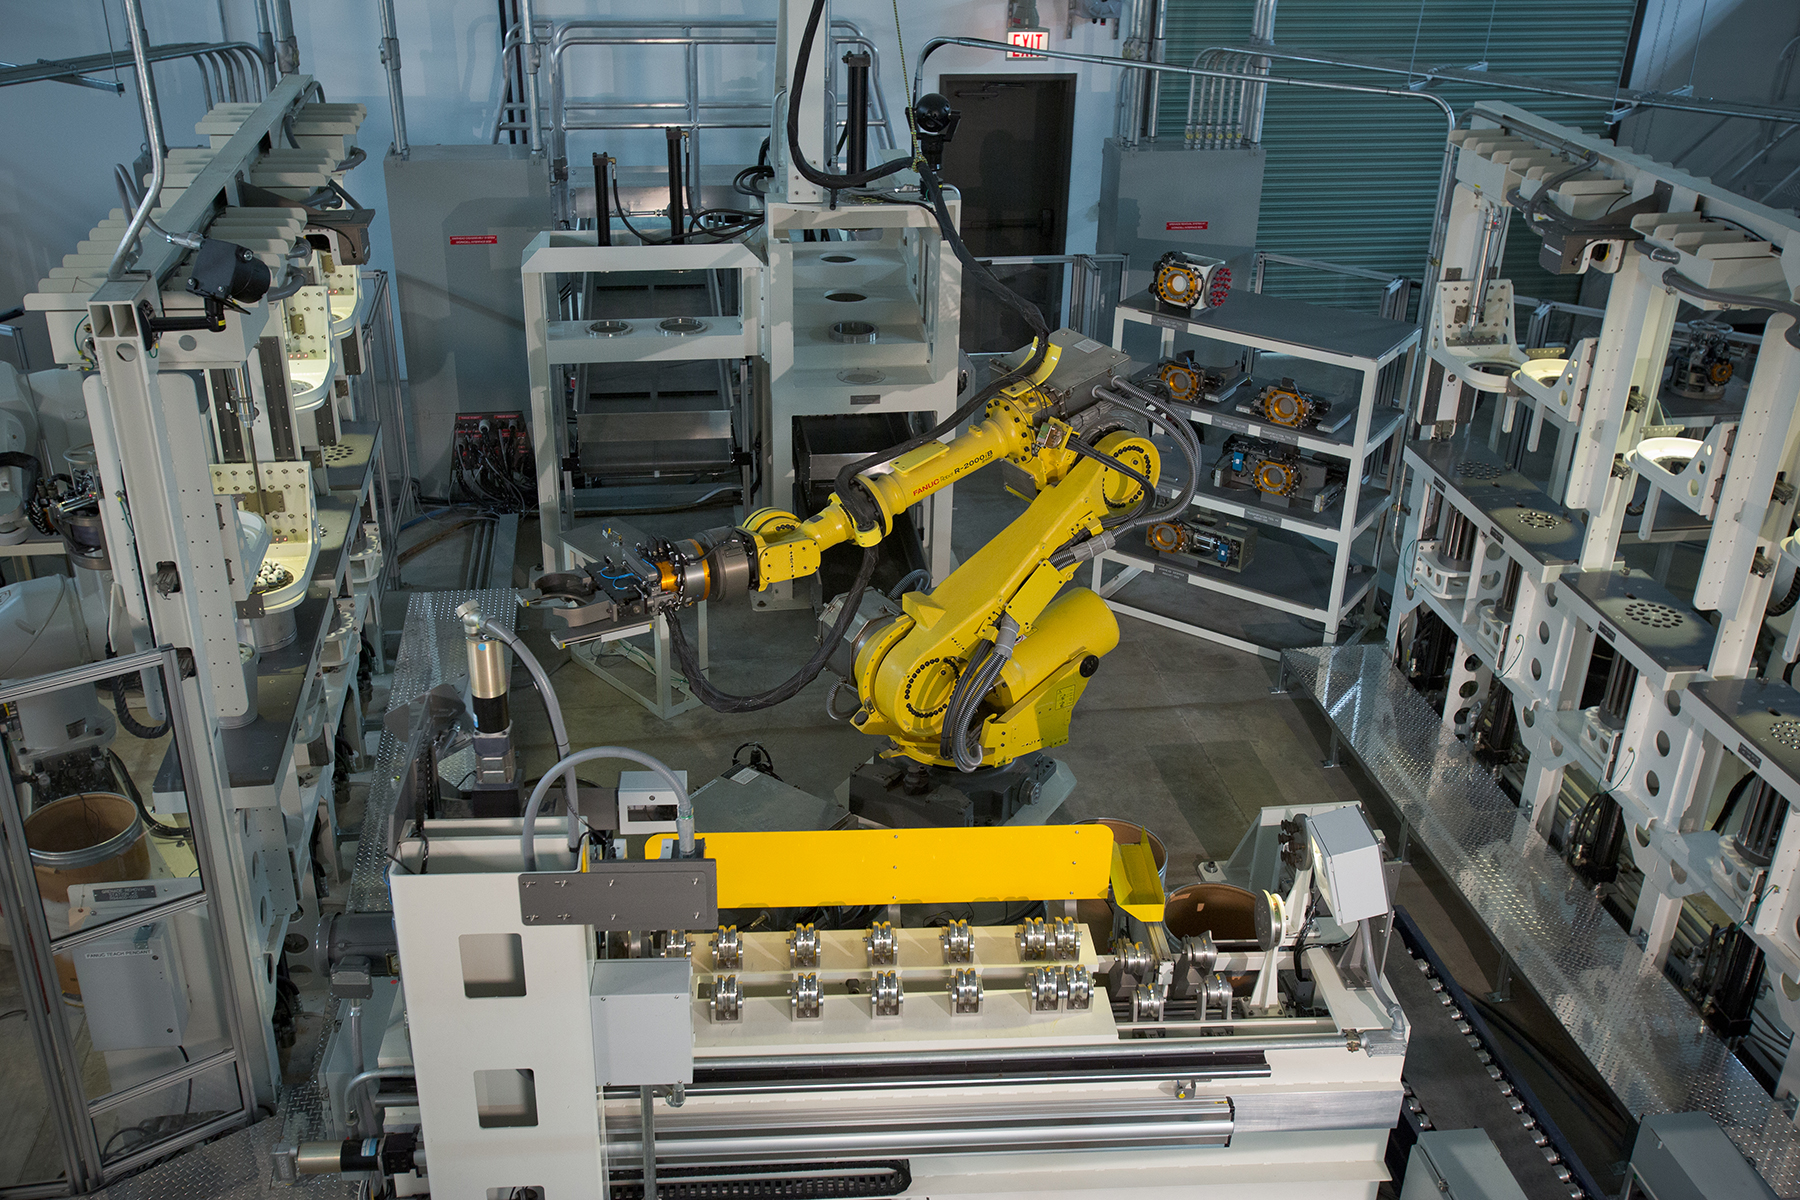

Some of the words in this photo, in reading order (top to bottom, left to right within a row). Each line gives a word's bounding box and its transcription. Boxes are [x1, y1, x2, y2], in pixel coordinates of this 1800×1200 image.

[1012, 34, 1043, 57] EXIT
[912, 478, 940, 496] FANUC
[954, 450, 994, 474] R-2000iB
